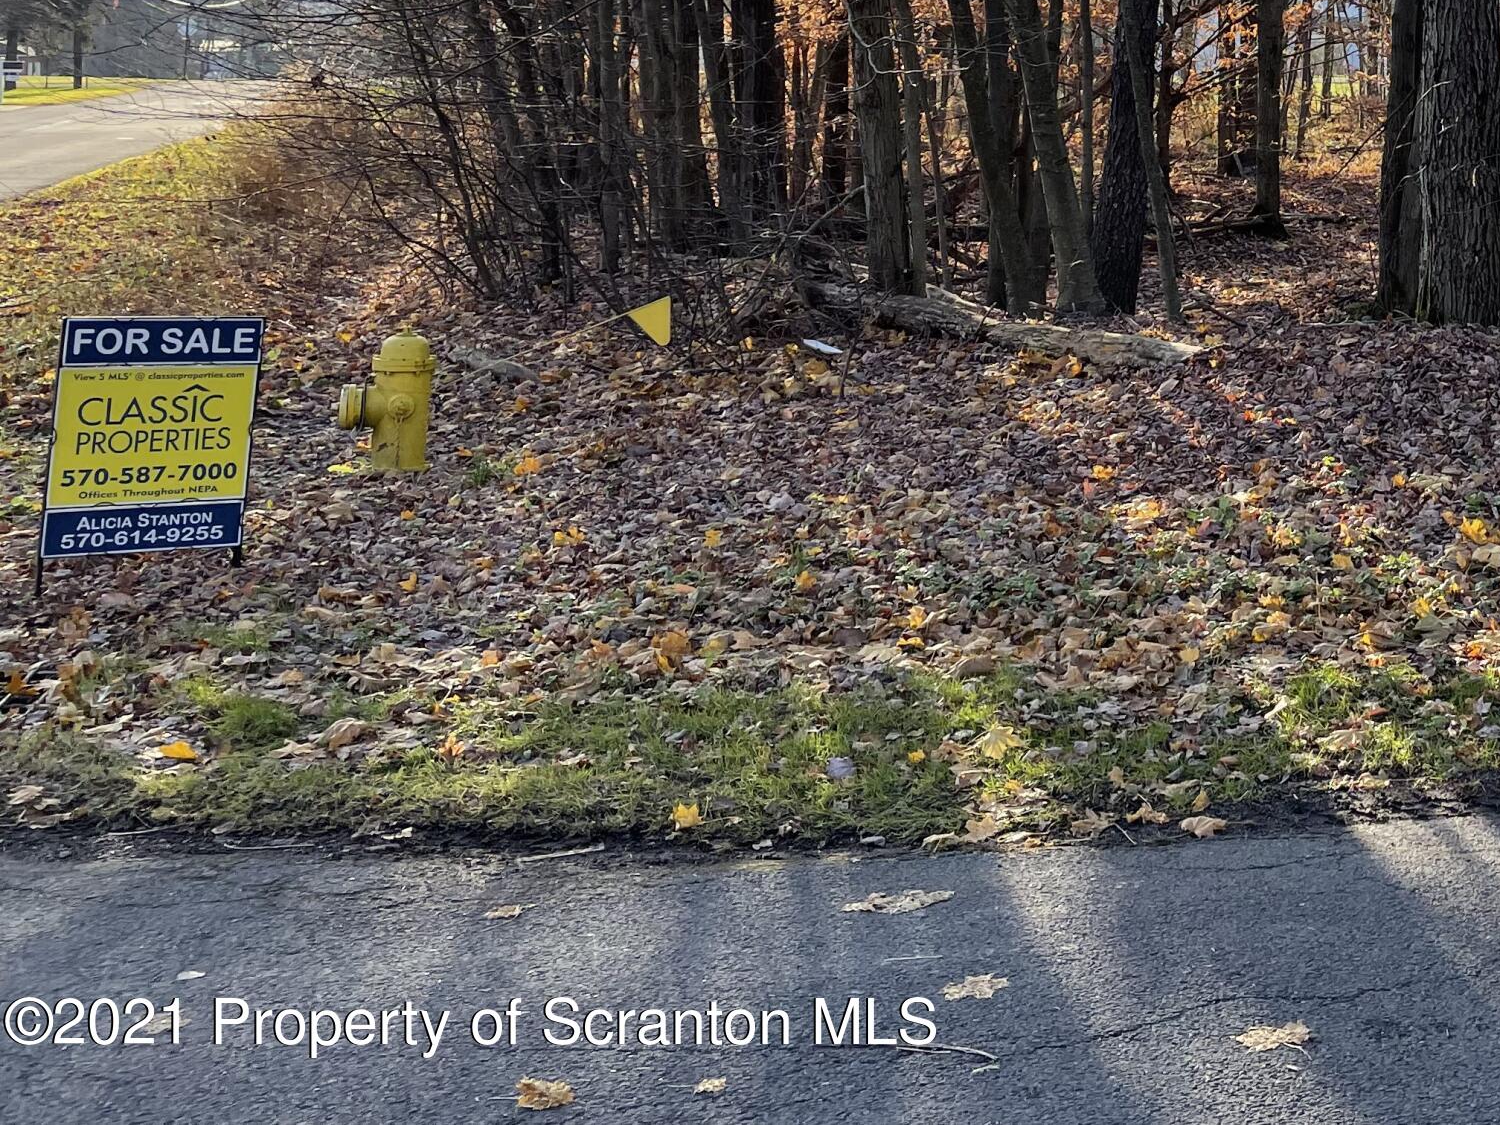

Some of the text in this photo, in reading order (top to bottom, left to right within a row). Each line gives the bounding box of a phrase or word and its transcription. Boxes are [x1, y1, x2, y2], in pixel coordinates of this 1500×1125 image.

[73, 328, 255, 355] FOR SALE
[148, 372, 245, 380] classicproperties.com
[78, 393, 224, 426] CLASSIC
[75, 427, 231, 455] PROPERTIES
[60, 463, 237, 487] 570-587-7000
[79, 485, 218, 498] Offices Throughout NEPA
[61, 525, 223, 549] 570-614-9255
